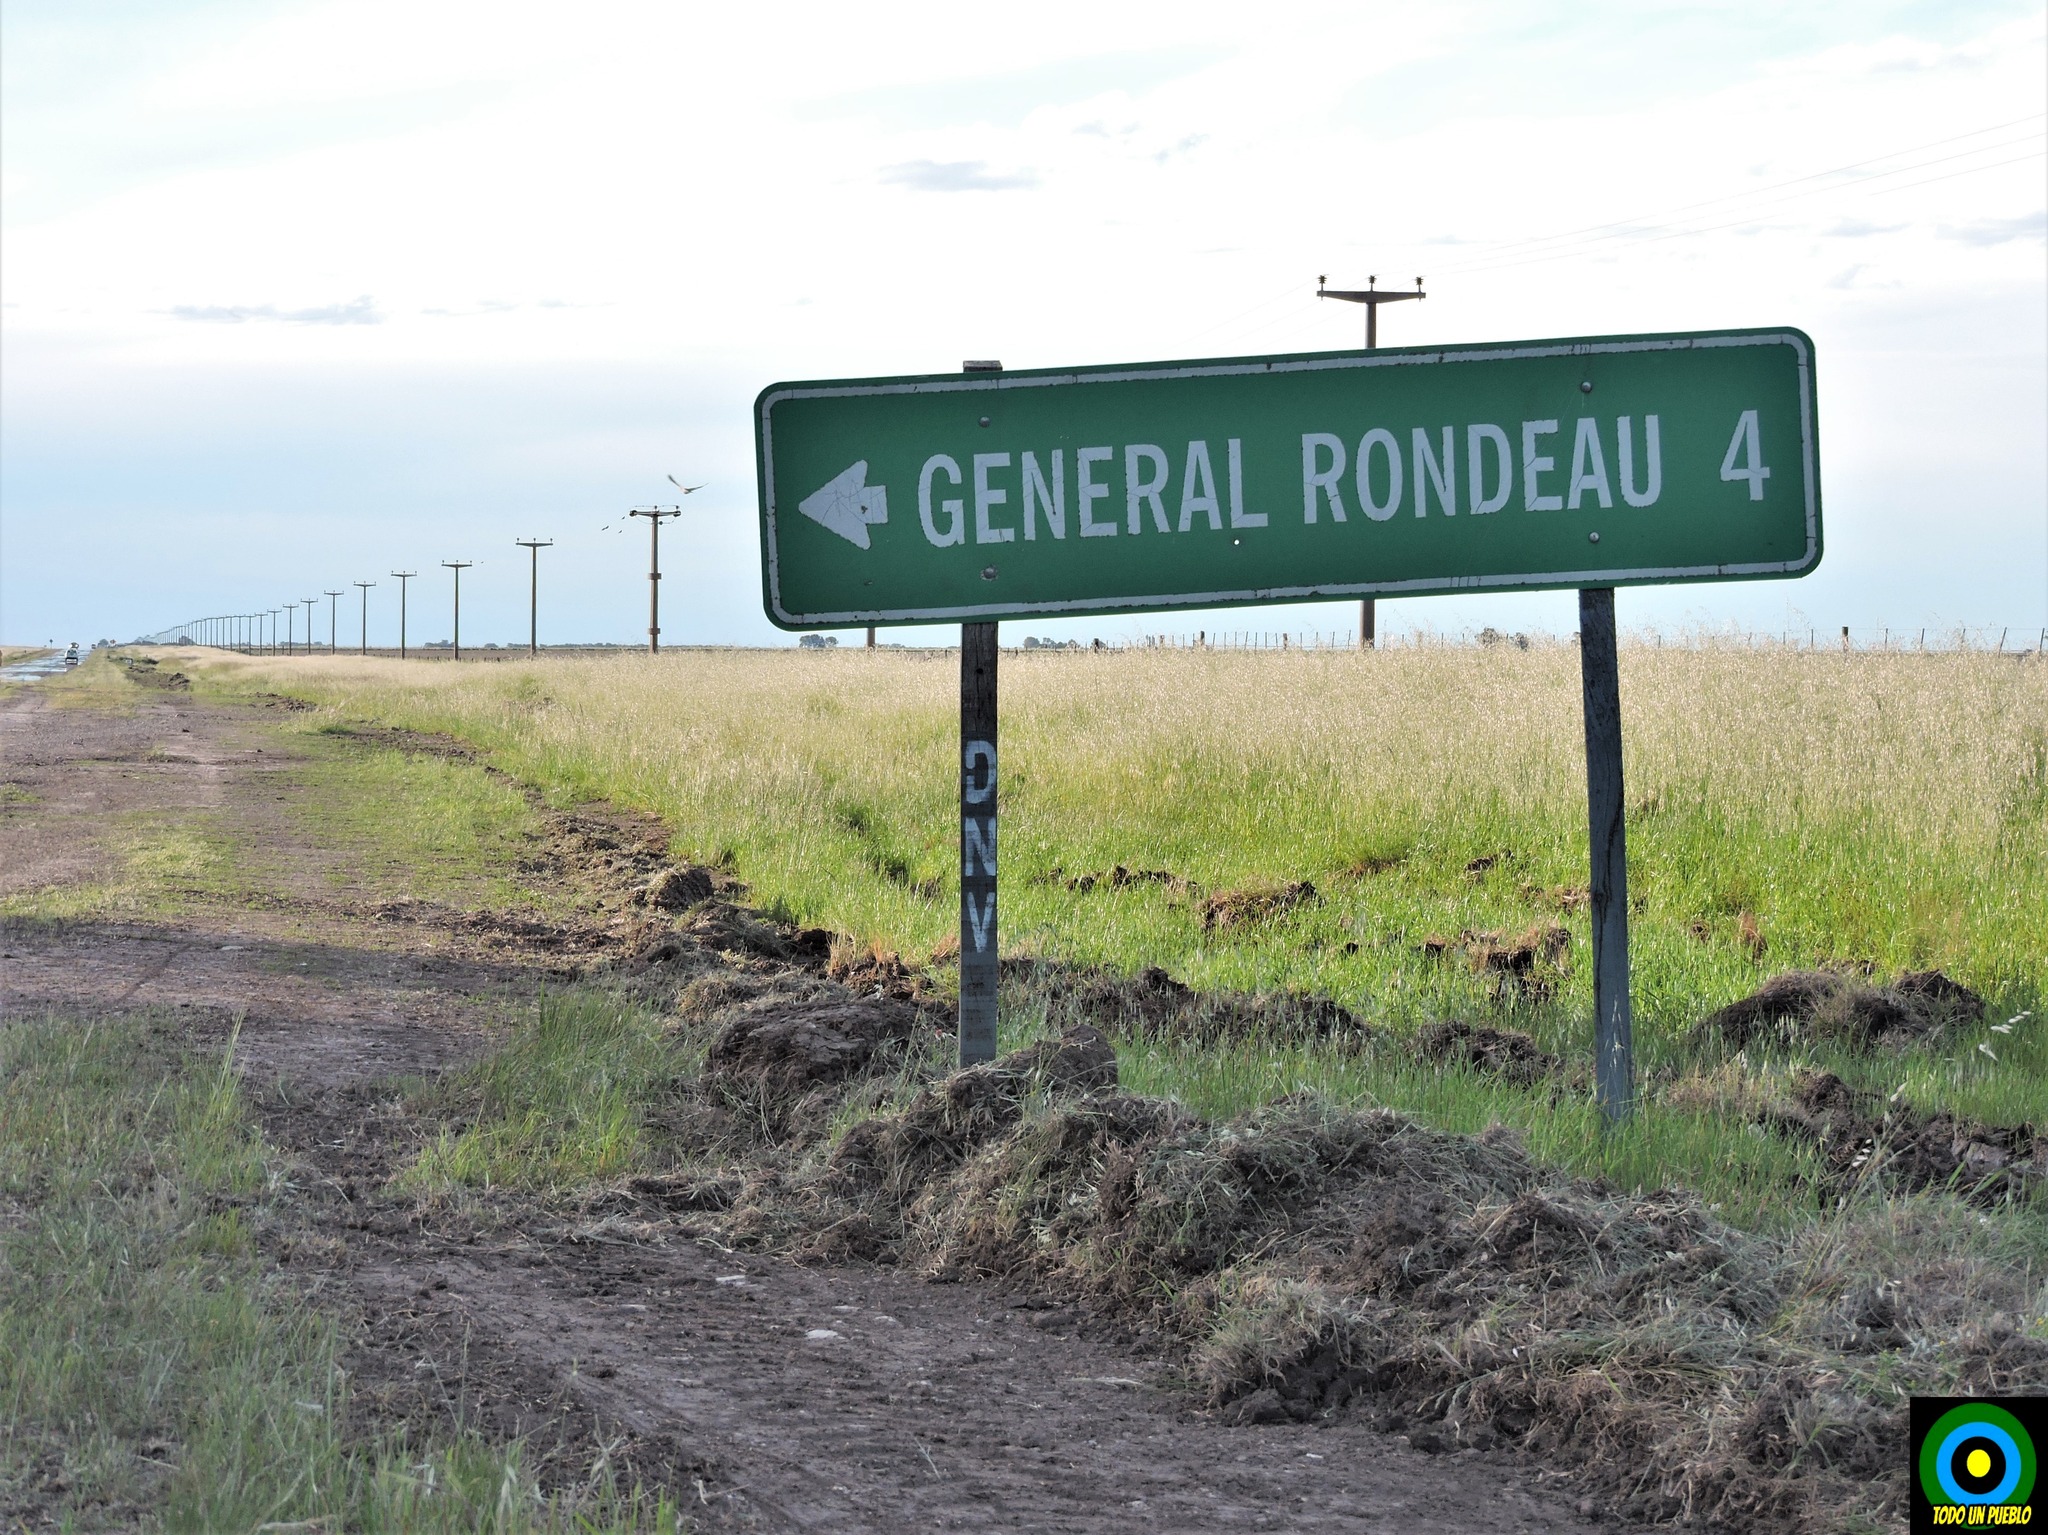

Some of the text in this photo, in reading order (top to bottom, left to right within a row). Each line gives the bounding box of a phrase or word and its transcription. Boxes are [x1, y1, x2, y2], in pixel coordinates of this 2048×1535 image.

[917, 409, 1771, 548] GENERAL RONDEAU 4
[964, 740, 997, 953] DNV
